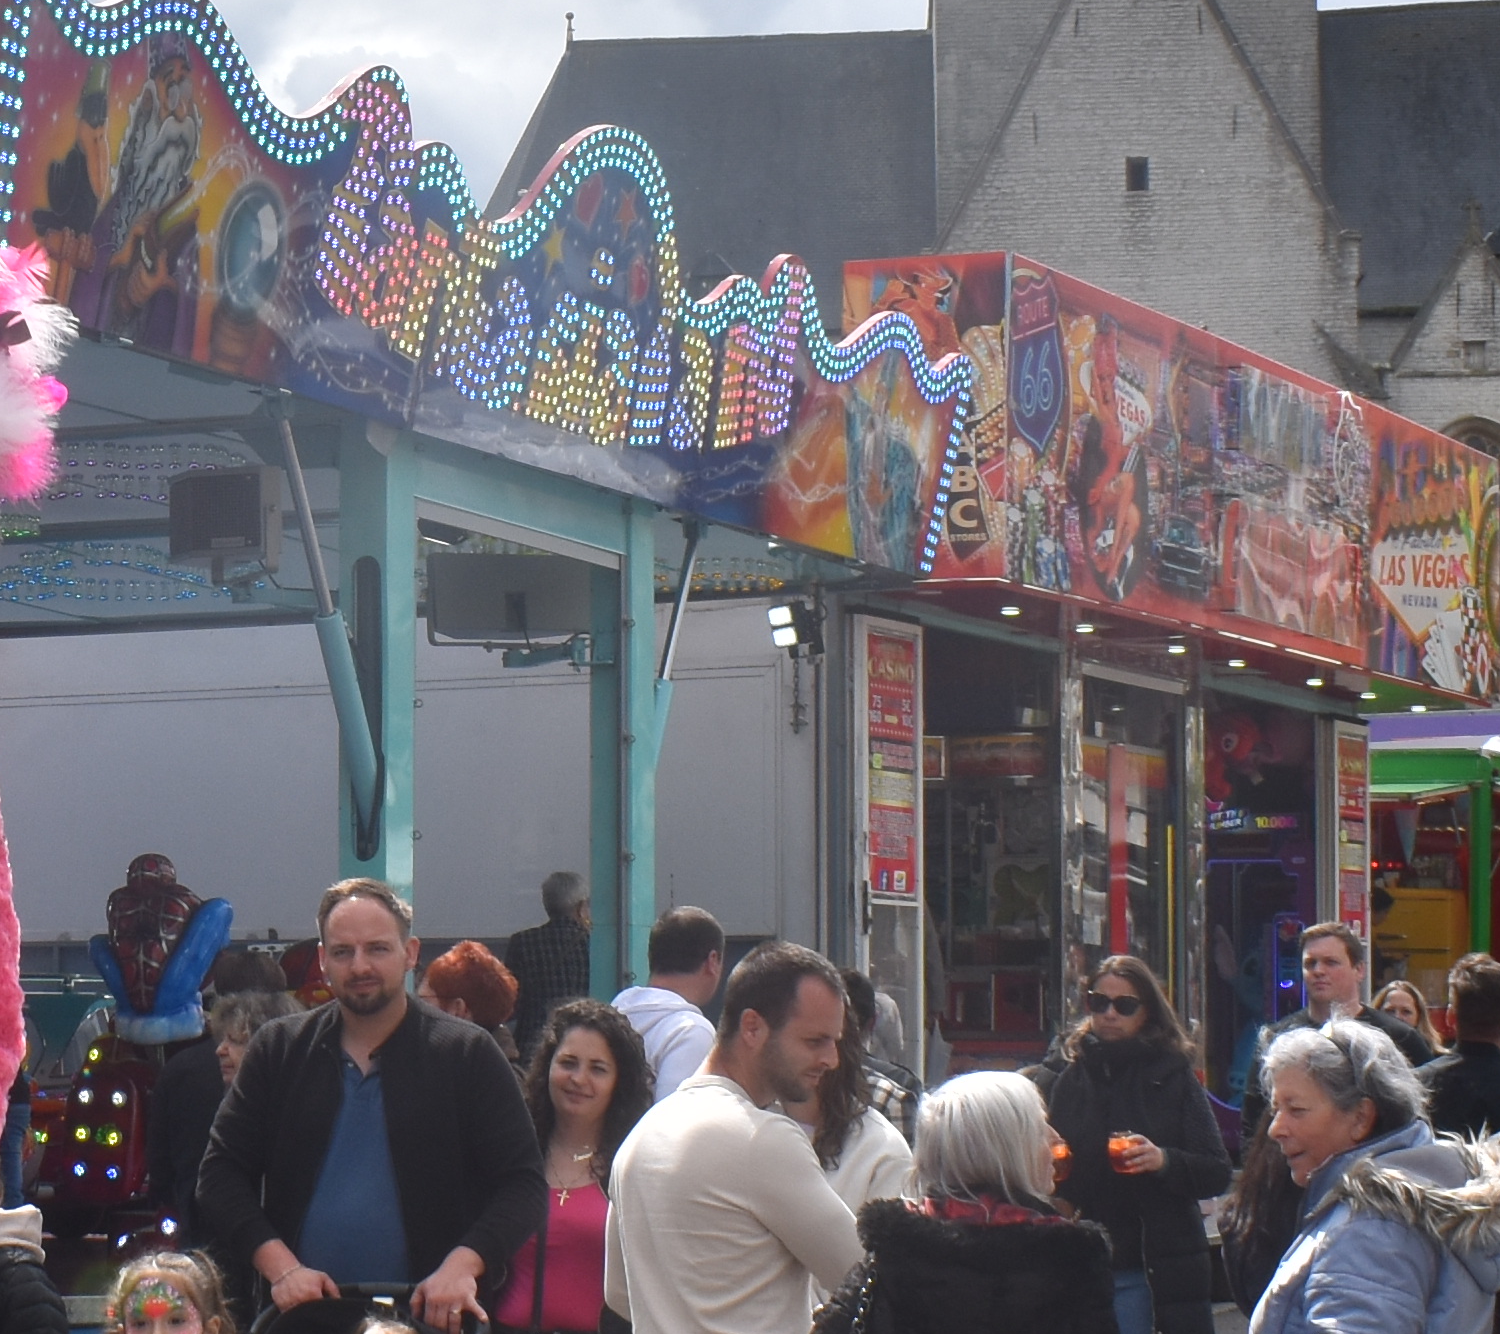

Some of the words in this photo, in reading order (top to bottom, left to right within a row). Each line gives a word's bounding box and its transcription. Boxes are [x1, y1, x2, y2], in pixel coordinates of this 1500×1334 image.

[1017, 295, 1049, 325] ROUTE
[1020, 339, 1053, 418] 66
[950, 531, 987, 543] STORES
[1379, 554, 1406, 586] LAS
[1412, 553, 1471, 589] VEGAS
[1402, 594, 1438, 609] NEVADA
